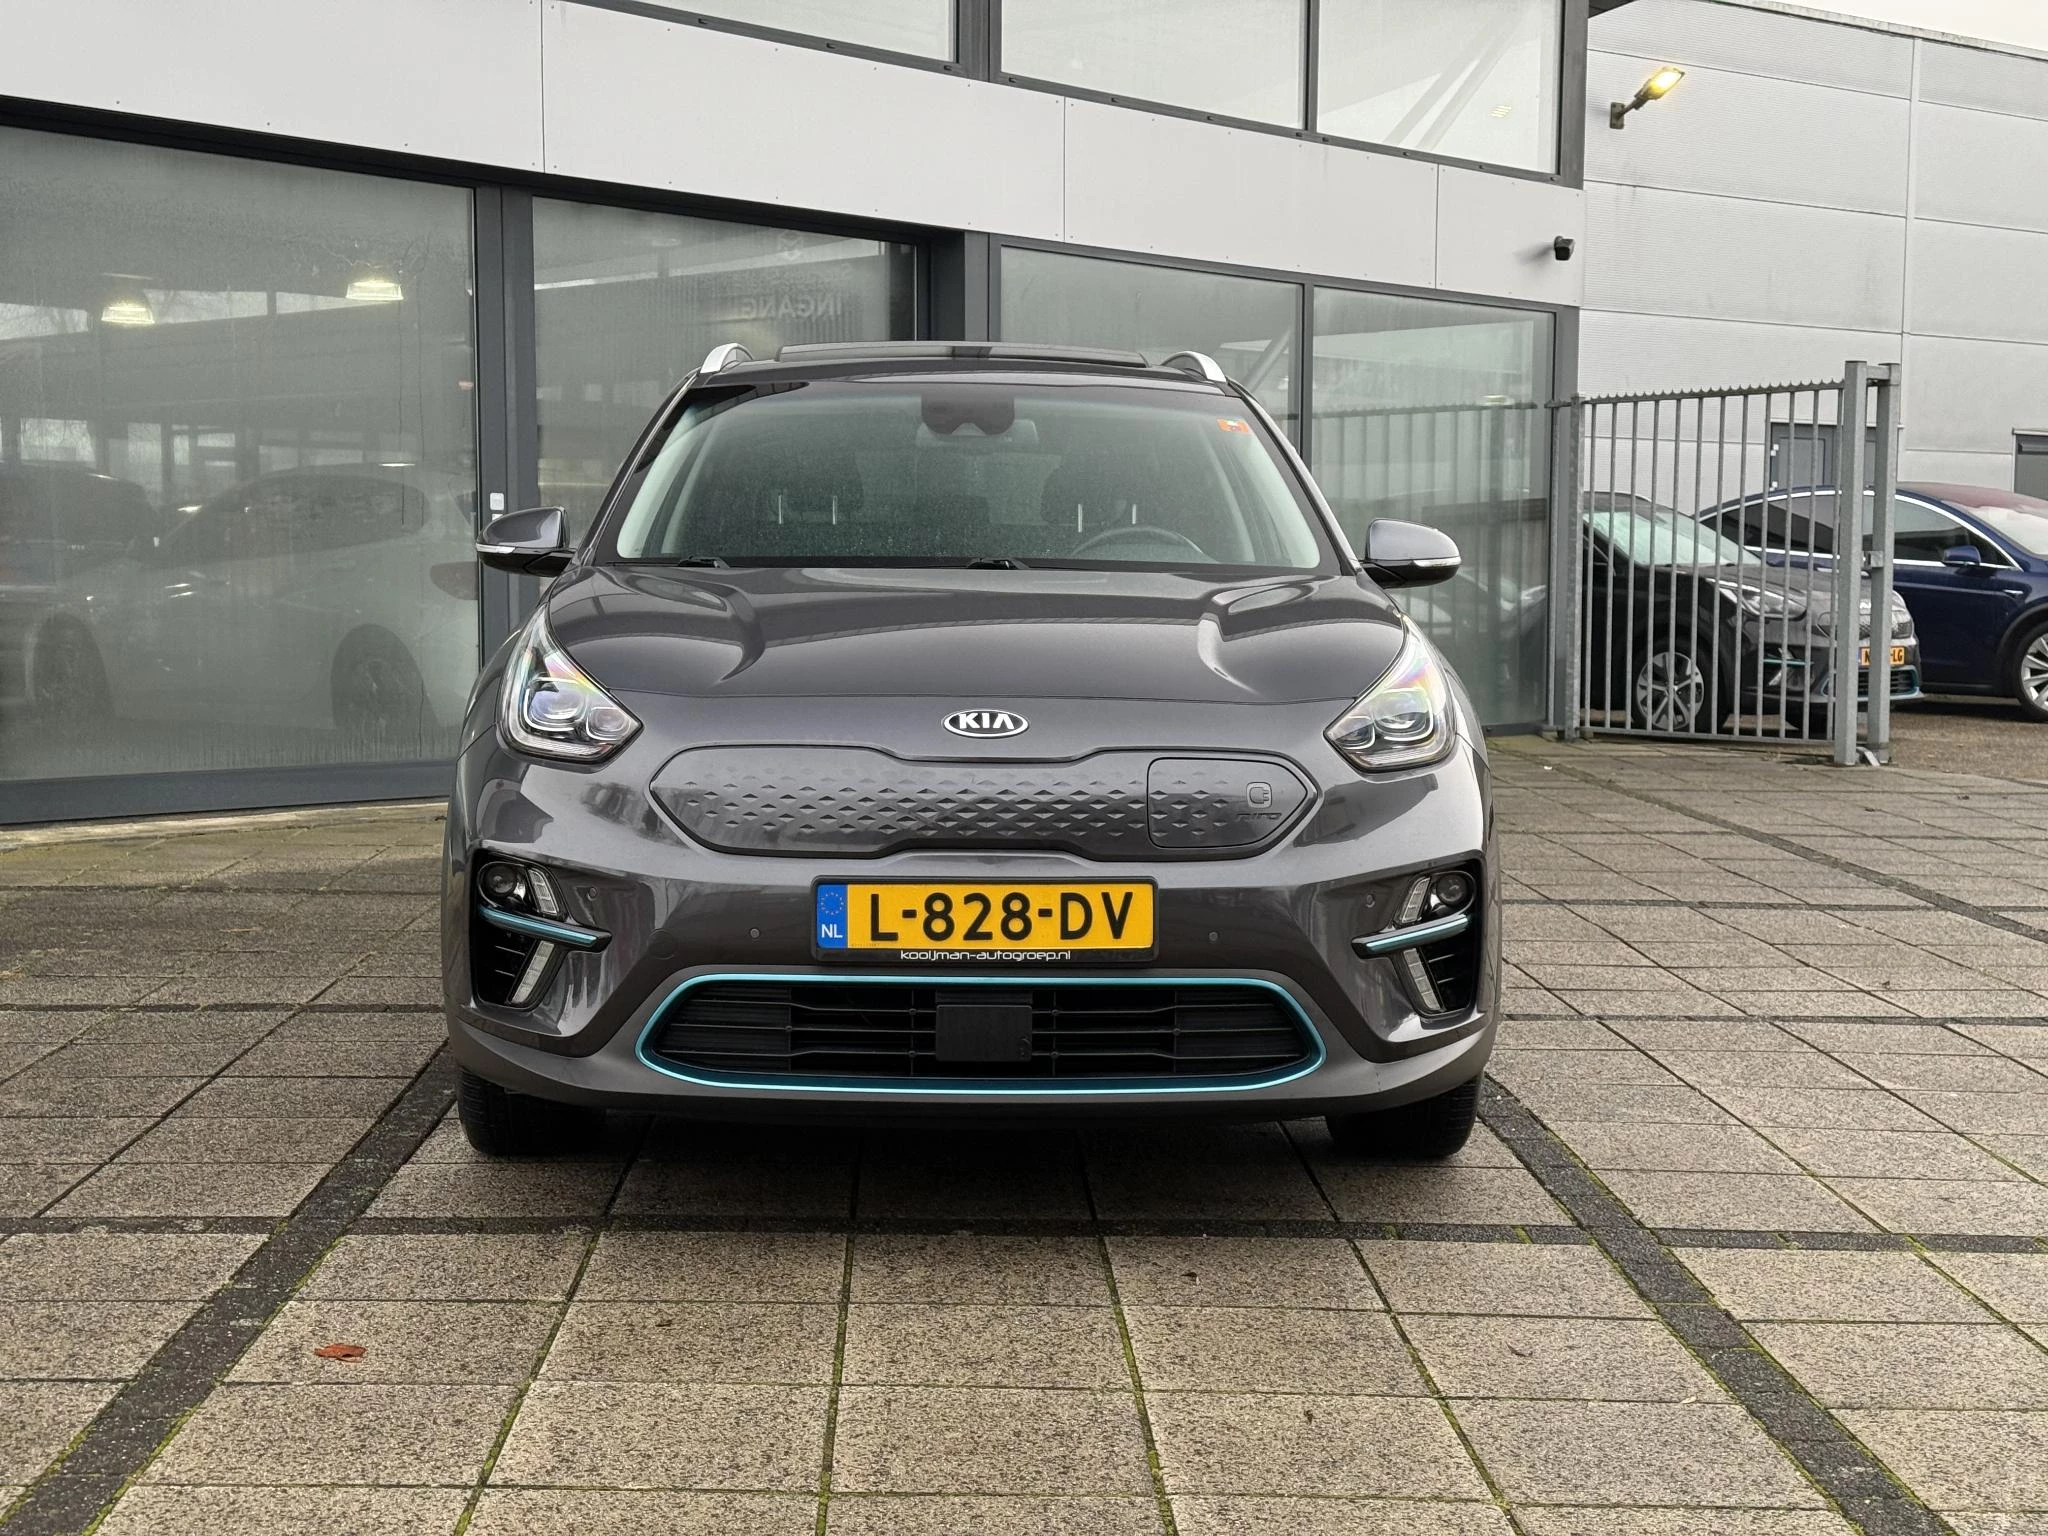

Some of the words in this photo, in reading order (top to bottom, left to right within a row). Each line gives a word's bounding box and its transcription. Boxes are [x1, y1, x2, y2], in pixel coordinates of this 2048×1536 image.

[959, 712, 1015, 730] KIA
[870, 891, 1134, 942] L-828-DV
[820, 923, 843, 939] NL
[900, 949, 1071, 961] kooijman-autogroep.nl
